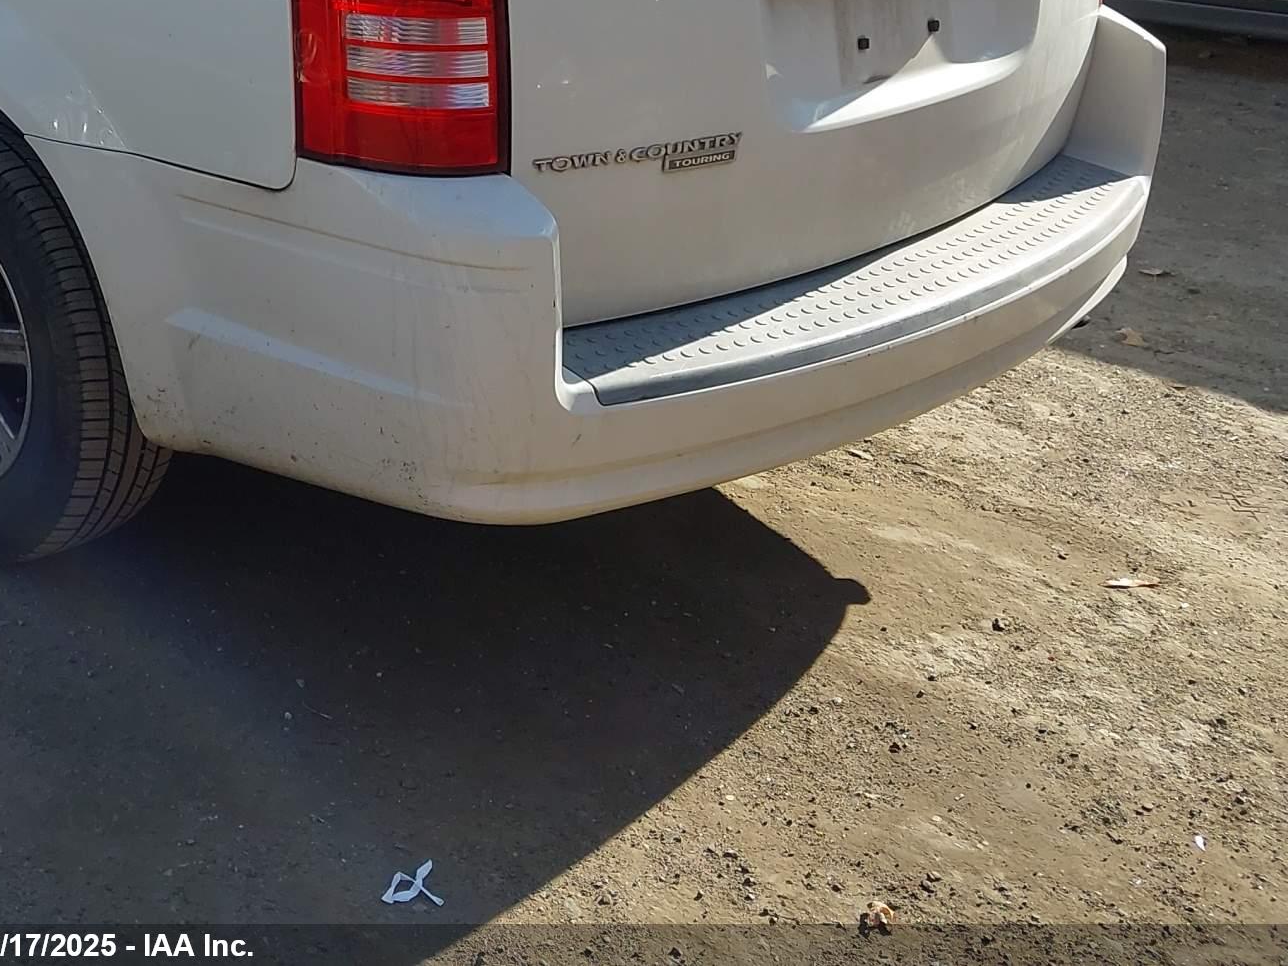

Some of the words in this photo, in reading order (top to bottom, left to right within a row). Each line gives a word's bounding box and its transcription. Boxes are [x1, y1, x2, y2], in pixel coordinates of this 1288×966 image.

[533, 151, 612, 173] TOWN
[615, 148, 626, 164] &
[630, 131, 743, 162] COUNTRY
[673, 152, 731, 168] TOURING
